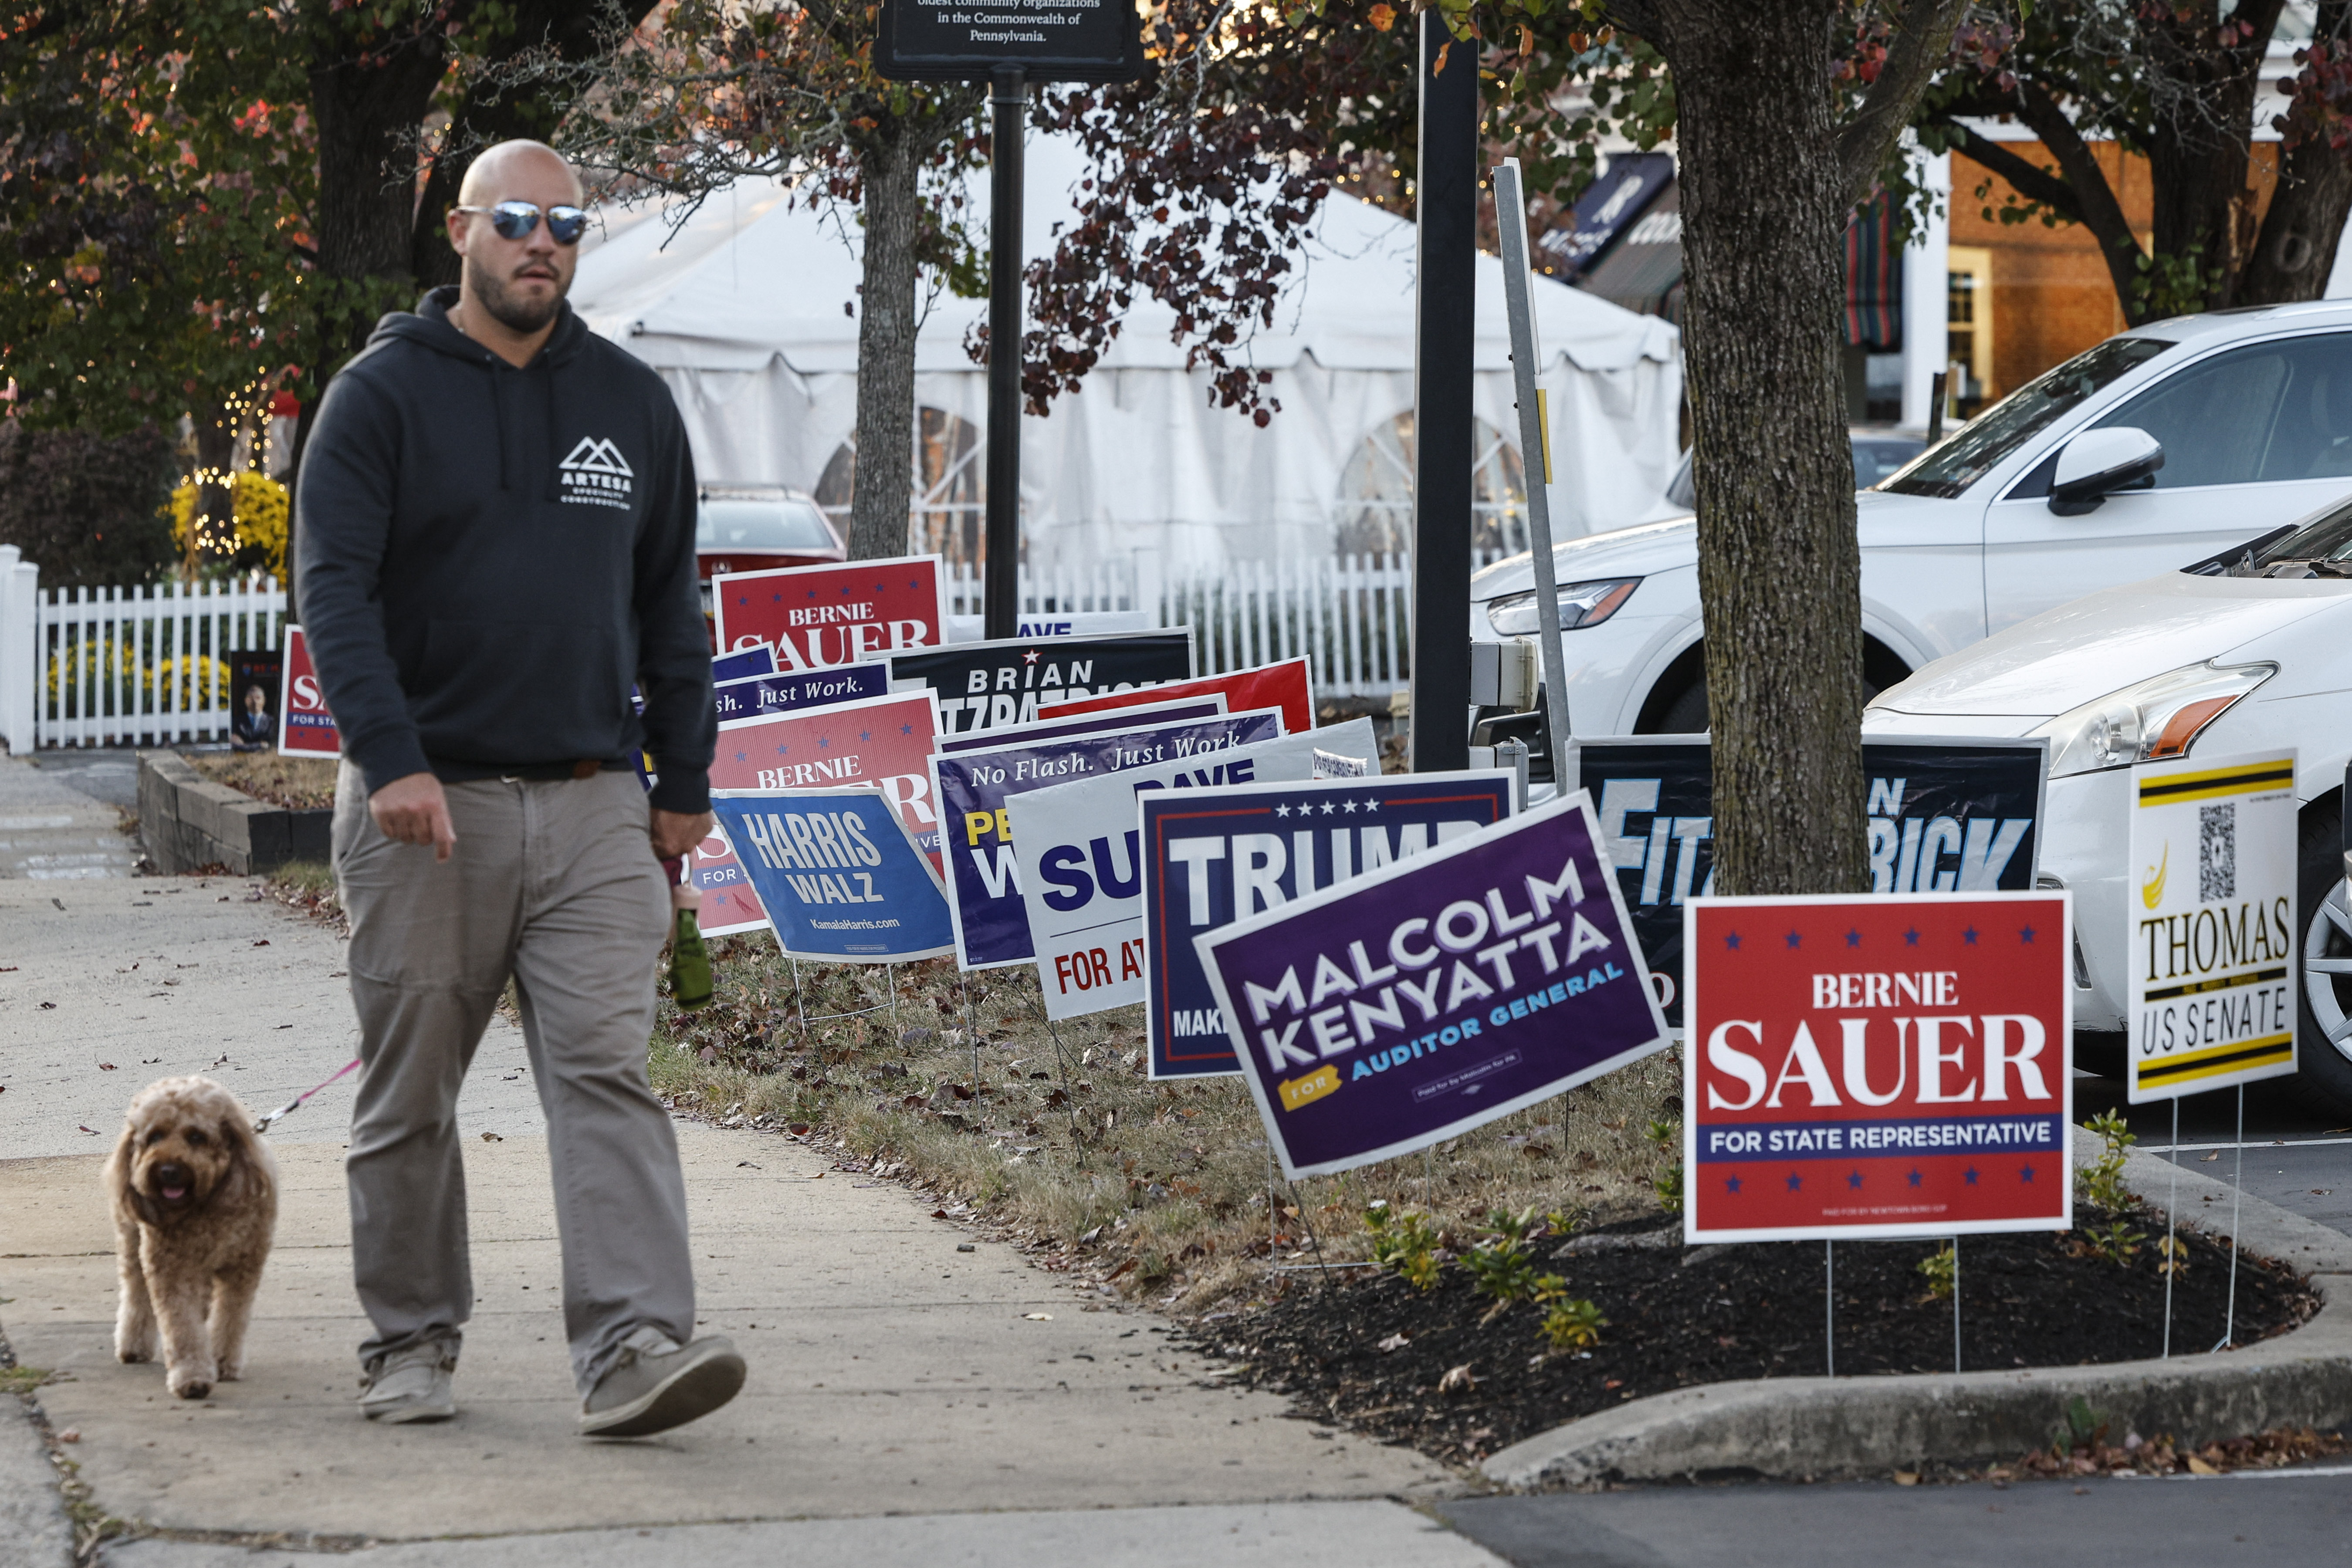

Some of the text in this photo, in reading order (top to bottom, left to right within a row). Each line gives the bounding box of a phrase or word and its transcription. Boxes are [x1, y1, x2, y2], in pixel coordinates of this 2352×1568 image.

[937, 12, 1082, 25] in the Commonwealth of
[955, 0, 1019, 10] community
[1023, 0, 1100, 10] organizations
[970, 30, 1047, 44] Pennsylvania.
[789, 602, 874, 626] BERNIE
[1019, 622, 1071, 637] AVE
[757, 685, 796, 708] Just
[805, 677, 863, 698] Work.
[967, 660, 1093, 693] BRIAN
[293, 715, 336, 727] FOR STA
[757, 755, 862, 789] BERNIE
[971, 767, 1005, 787] No
[1016, 753, 1094, 781] Flash.
[1111, 744, 1164, 770] Just
[741, 811, 881, 869] HARRIS
[1599, 778, 2033, 906] FITRICK
[703, 869, 736, 884] FOR
[785, 872, 884, 904] WALZ
[1168, 820, 1483, 926] TRU
[809, 919, 900, 929] KamalaHarris.com
[2140, 896, 2289, 982] THOMAS
[1243, 857, 1585, 1025] MALCOLM
[1054, 947, 1113, 995] FOR
[1260, 912, 1612, 1074] KENYATTA
[1812, 971, 1959, 1009] BERNIE
[1173, 1010, 1228, 1038] MAK
[1291, 1076, 1327, 1100] FOR
[1351, 1016, 1482, 1081] AUDITOR
[1490, 962, 1624, 1027] GENERAL
[2142, 987, 2287, 1056] US SENATE
[1707, 1014, 2052, 1111] SAUER
[1710, 1121, 2052, 1153] FOR STATE REPRESENTATIVE
